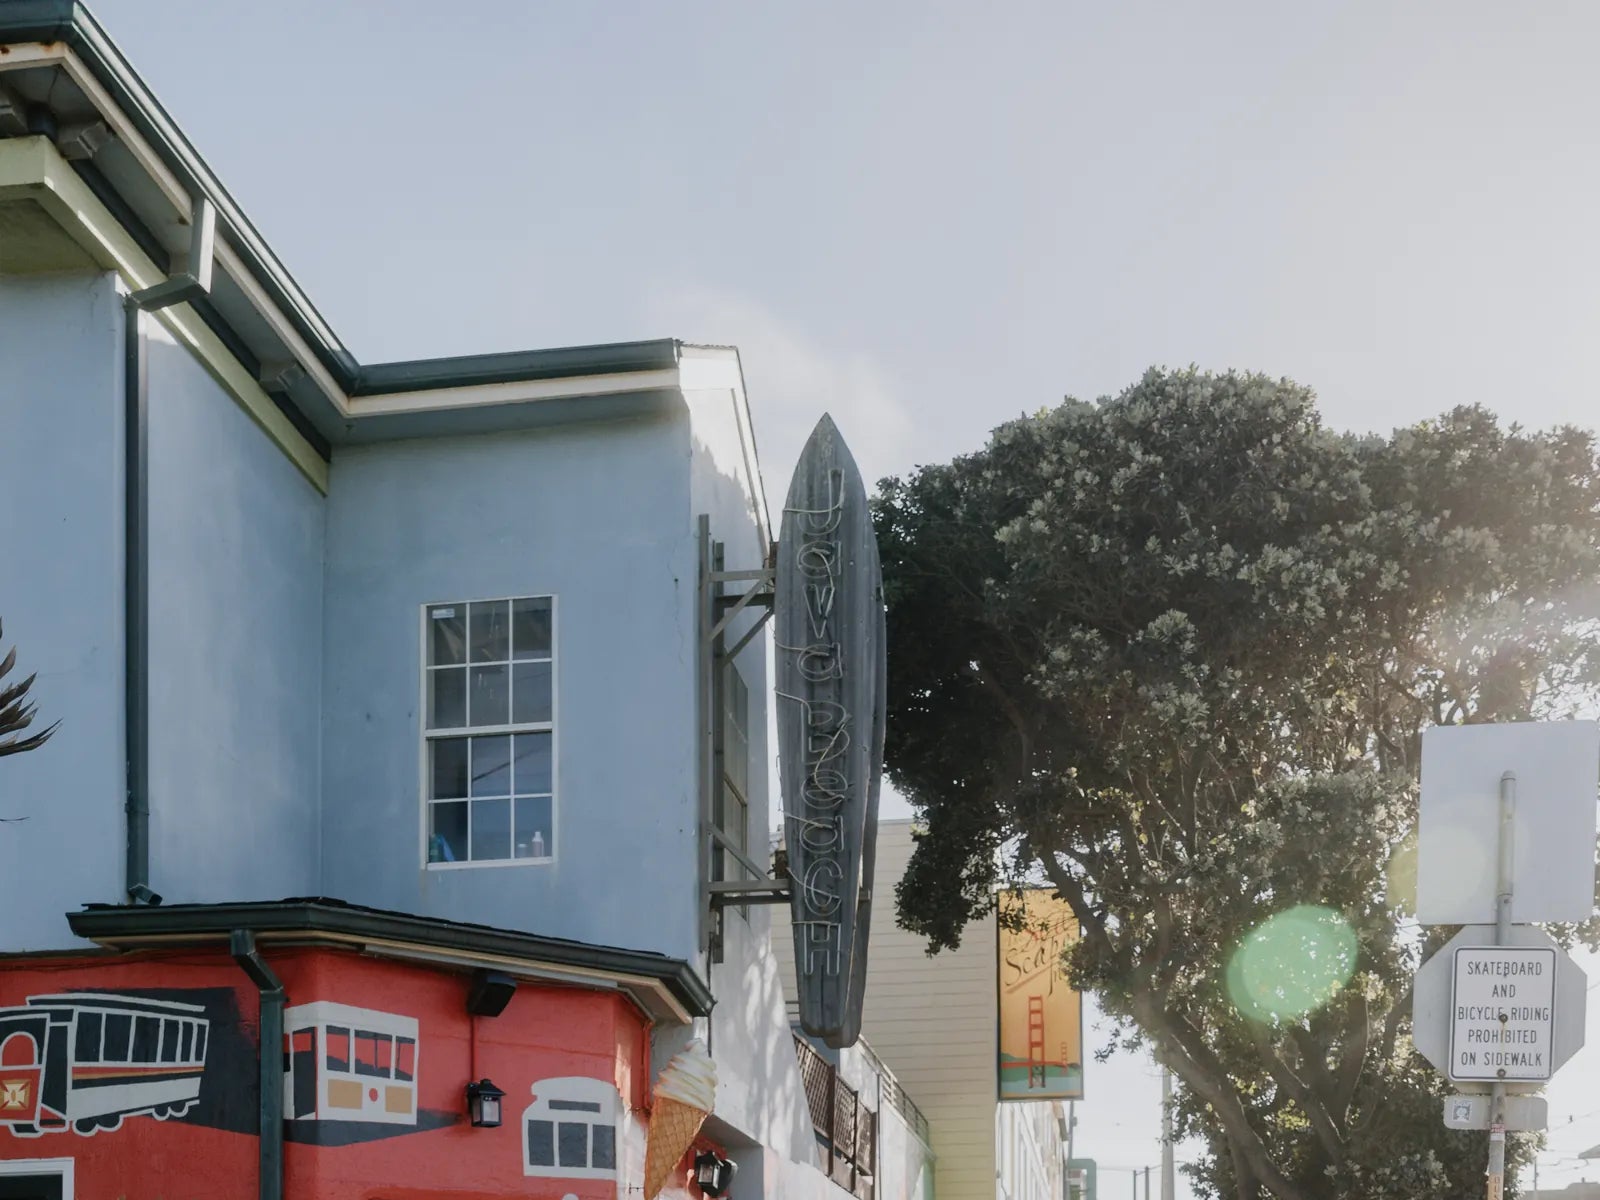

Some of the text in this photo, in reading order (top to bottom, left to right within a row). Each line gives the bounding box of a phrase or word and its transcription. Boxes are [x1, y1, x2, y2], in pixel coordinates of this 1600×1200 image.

[1467, 961, 1542, 976] SKATEBOARD
[1492, 984, 1516, 998] AND
[1511, 1007, 1549, 1021] RIDING
[1468, 1029, 1537, 1043] PROHIBITED
[1461, 1052, 1542, 1066] ON SIDEWALK
